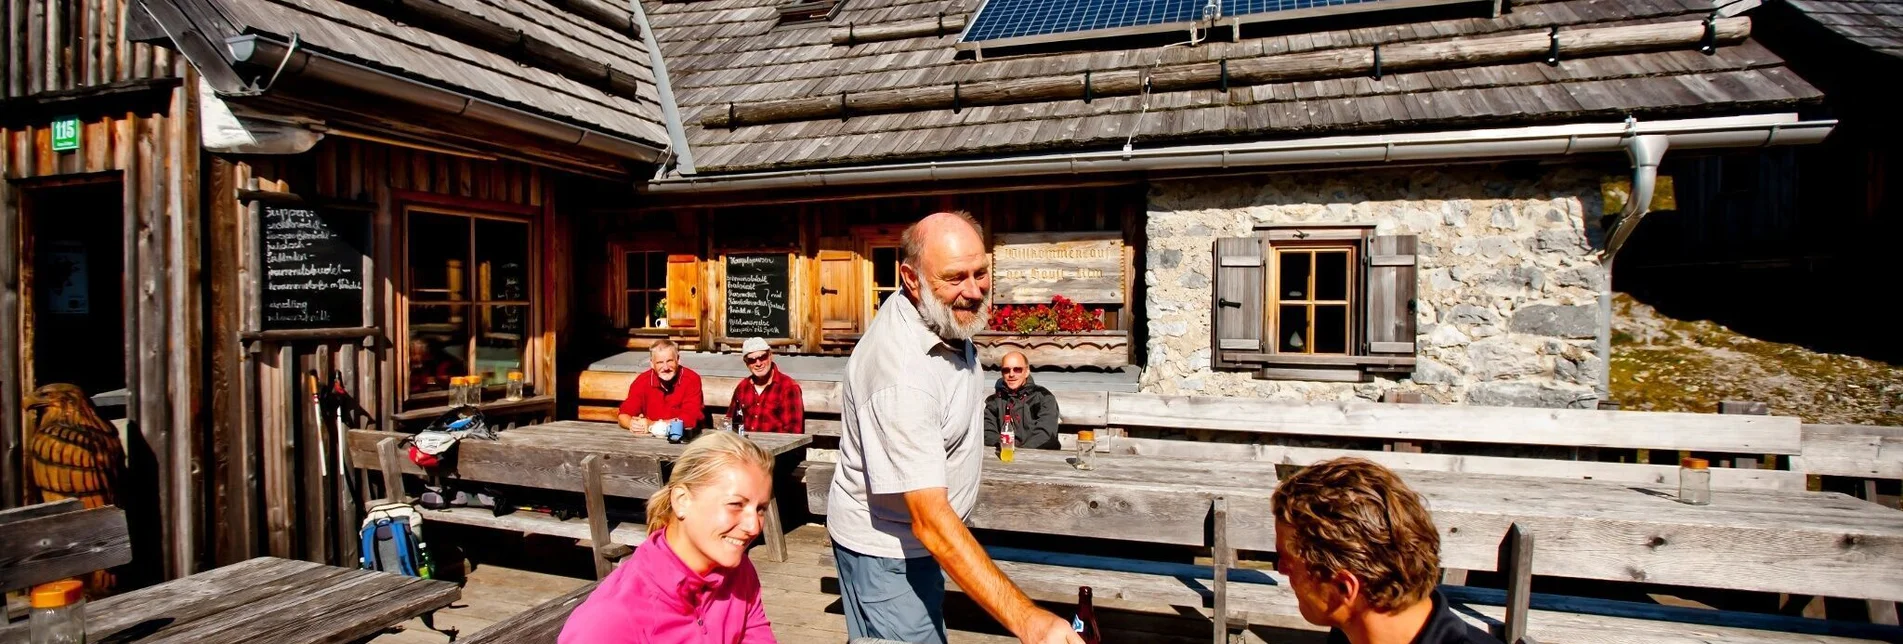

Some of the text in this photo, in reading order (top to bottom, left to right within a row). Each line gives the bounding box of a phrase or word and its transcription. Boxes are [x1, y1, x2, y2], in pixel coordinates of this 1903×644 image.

[56, 120, 75, 139] 115
[1005, 246, 1112, 260] Willkommen auf
